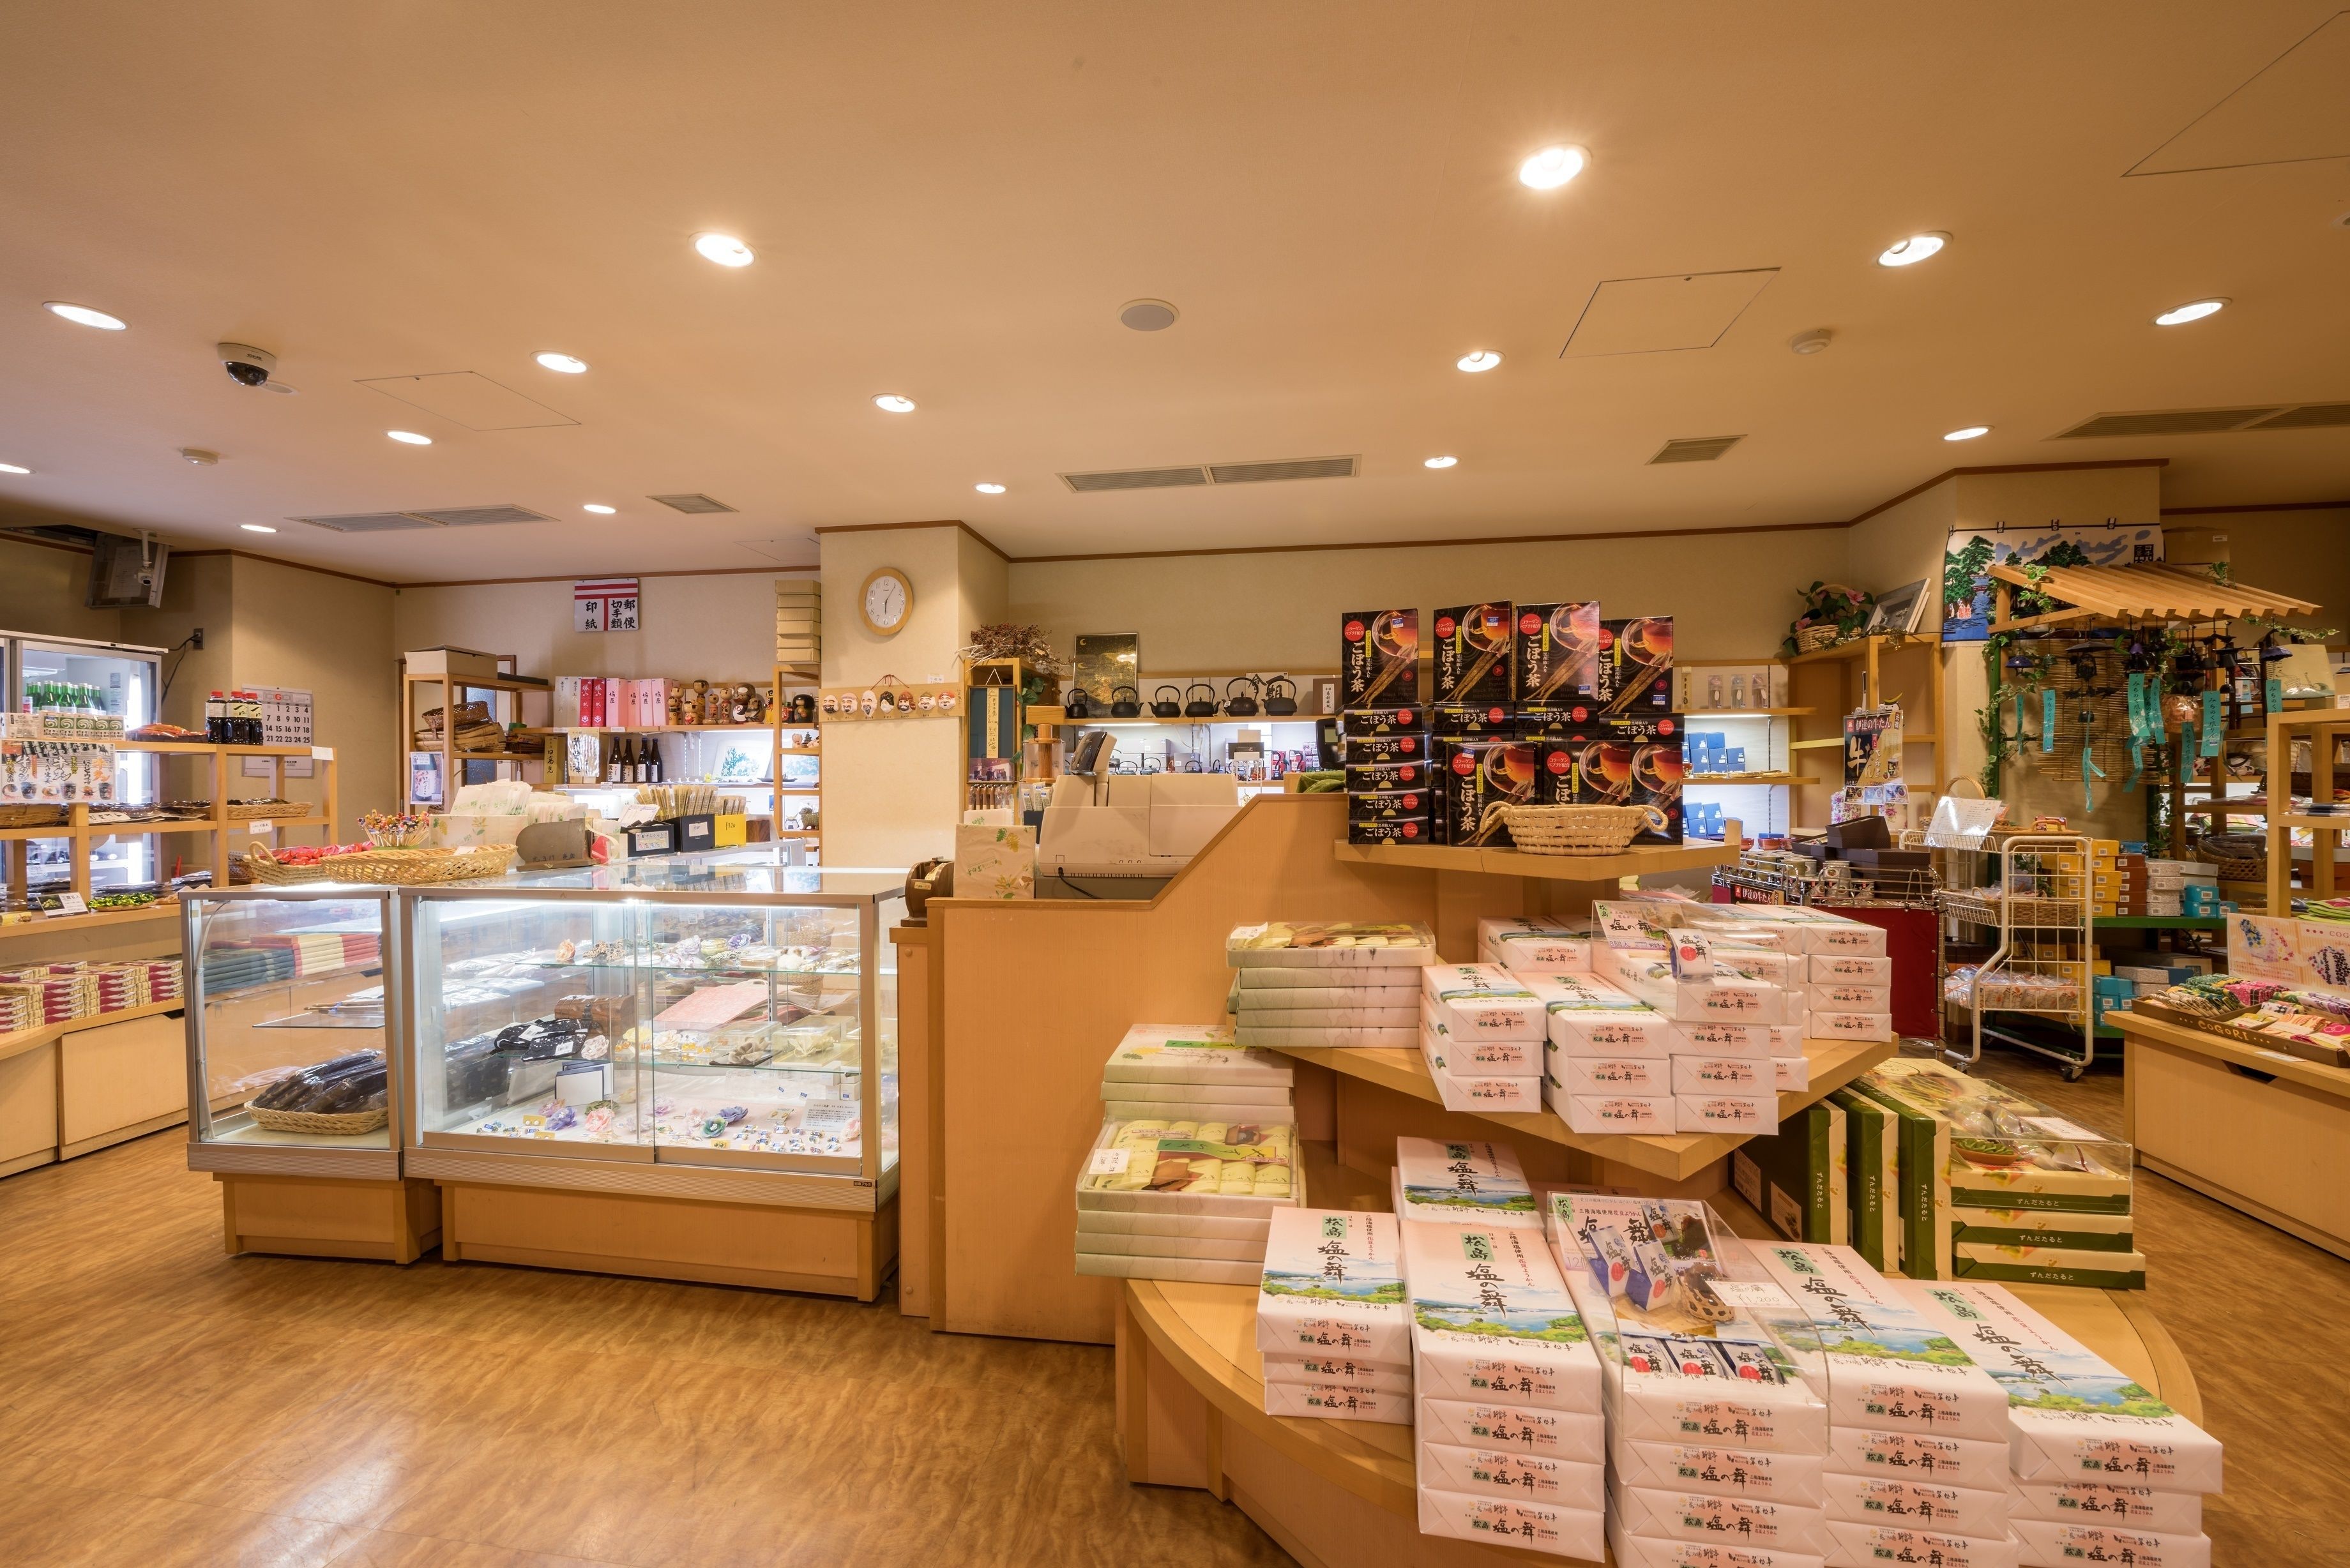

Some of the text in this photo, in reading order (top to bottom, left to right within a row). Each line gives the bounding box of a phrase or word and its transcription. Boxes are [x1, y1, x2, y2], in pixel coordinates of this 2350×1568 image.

[585, 600, 598, 630] 印紙
[610, 599, 623, 629] 切手類
[623, 598, 636, 629] 郵便
[1351, 641, 1365, 693] ごぼう茶
[1441, 638, 1455, 690] ごぼう茶
[1526, 635, 1542, 687] ごぼう茶
[1598, 650, 1614, 702] ごぼう茶
[1360, 715, 1397, 725] ごぼう茶
[1451, 713, 1488, 723] ごぼう茶
[1533, 712, 1571, 721] ごぼう茶
[1856, 718, 1891, 731] 伊達の牛たん
[1617, 725, 1656, 735] ごぼう茶
[1363, 743, 1400, 753] ごぼう茶
[1362, 771, 1399, 781] ごぼう茶
[1365, 799, 1402, 810] ごぼう茶
[1460, 776, 1476, 832] ごぼう茶
[1365, 827, 1402, 838] ごぼう茶
[1742, 889, 1773, 905] 伊達の牛たん
[1609, 918, 1653, 935] 塩の舞
[1679, 935, 1706, 964] 塩の舞
[1719, 999, 1745, 1011] 塩の舞
[1489, 1018, 1513, 1030] 塩の舞
[1604, 1033, 1631, 1047] 塩の舞
[1607, 1071, 1634, 1085] 塩の舞
[1713, 1070, 1739, 1085] 塩の舞
[1613, 1107, 1640, 1125] 塩の舞
[1717, 1110, 1742, 1124] 塩の舞
[1449, 1145, 1466, 1159] 松島
[1447, 1161, 1479, 1196] 塩の舞
[2017, 1198, 2060, 1207] ずんだたると
[1326, 1217, 1343, 1237] 松島
[2019, 1235, 2063, 1244] ずんだたると
[1464, 1235, 1488, 1260] 松島
[1317, 1240, 1350, 1286] 塩の舞
[1777, 1249, 1814, 1274] 松島
[2030, 1271, 2074, 1281] ずんだたると
[1465, 1263, 1507, 1319] 塩の舞
[1801, 1277, 1876, 1337] 塩の舞
[1933, 1291, 1978, 1319] 松島
[1317, 1332, 1353, 1353] 塩の舞
[1628, 1343, 1662, 1373] 塩の舞
[1679, 1348, 1717, 1375] 塩の舞
[1737, 1352, 1774, 1382] 塩の舞
[1972, 1323, 2069, 1388] 塩の舞
[1321, 1360, 1356, 1383] 塩の舞
[1471, 1375, 1533, 1401] 松島 塩の舞
[1324, 1394, 1359, 1415] 塩の舞
[1866, 1401, 1935, 1428] 松島 塩の舞
[1473, 1424, 1535, 1451] 松島 塩の舞
[1682, 1418, 1750, 1445] 松島 塩の舞
[1866, 1450, 1935, 1477] 松島 塩の舞
[2082, 1456, 2151, 1481] 松島 塩の舞
[1474, 1468, 1536, 1495] 松島 塩の舞
[1679, 1465, 1748, 1493] 松島 塩の舞
[1865, 1498, 1934, 1525] 松島 塩の舞
[2059, 1495, 2129, 1522] 松島 塩の舞
[1473, 1518, 1535, 1545] 松島 塩の舞
[1685, 1514, 1753, 1542] 松島 塩の舞
[1875, 1546, 1944, 1568] 松島 塩の舞
[2065, 1545, 2136, 1568] 松島 塩の舞
